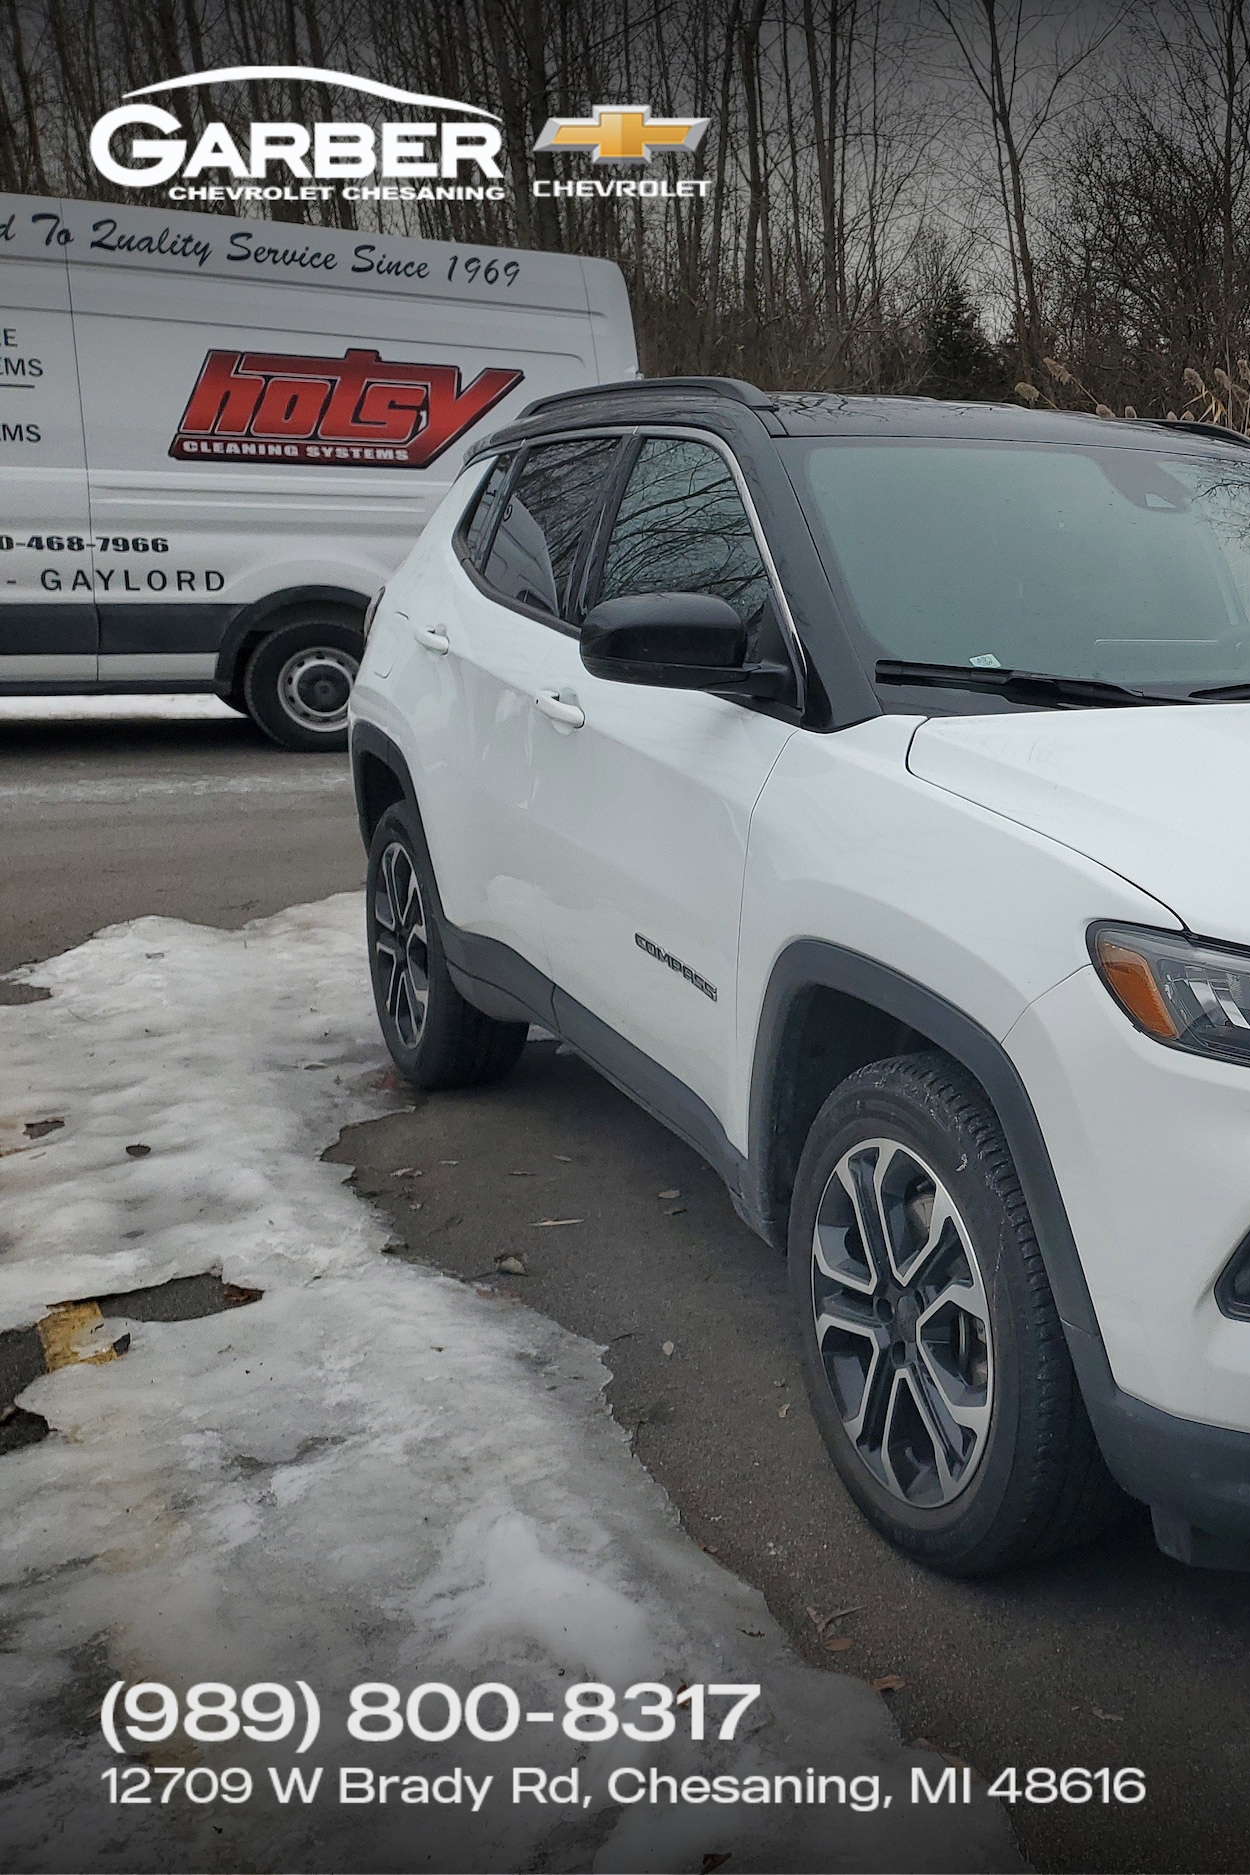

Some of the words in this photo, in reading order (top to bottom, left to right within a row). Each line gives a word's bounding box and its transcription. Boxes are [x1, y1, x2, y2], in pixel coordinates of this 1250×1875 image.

[31, 213, 74, 246] To
[90, 219, 213, 267] Quality
[227, 232, 337, 270] Service
[351, 244, 430, 279] Since
[446, 255, 520, 287] 1969
[0, 423, 41, 443] MS
[183, 440, 299, 457] CLEANING
[305, 445, 409, 461] SYSTEMS
[40, 568, 225, 592] GAYLORD
[634, 931, 718, 1003] COMPASS
